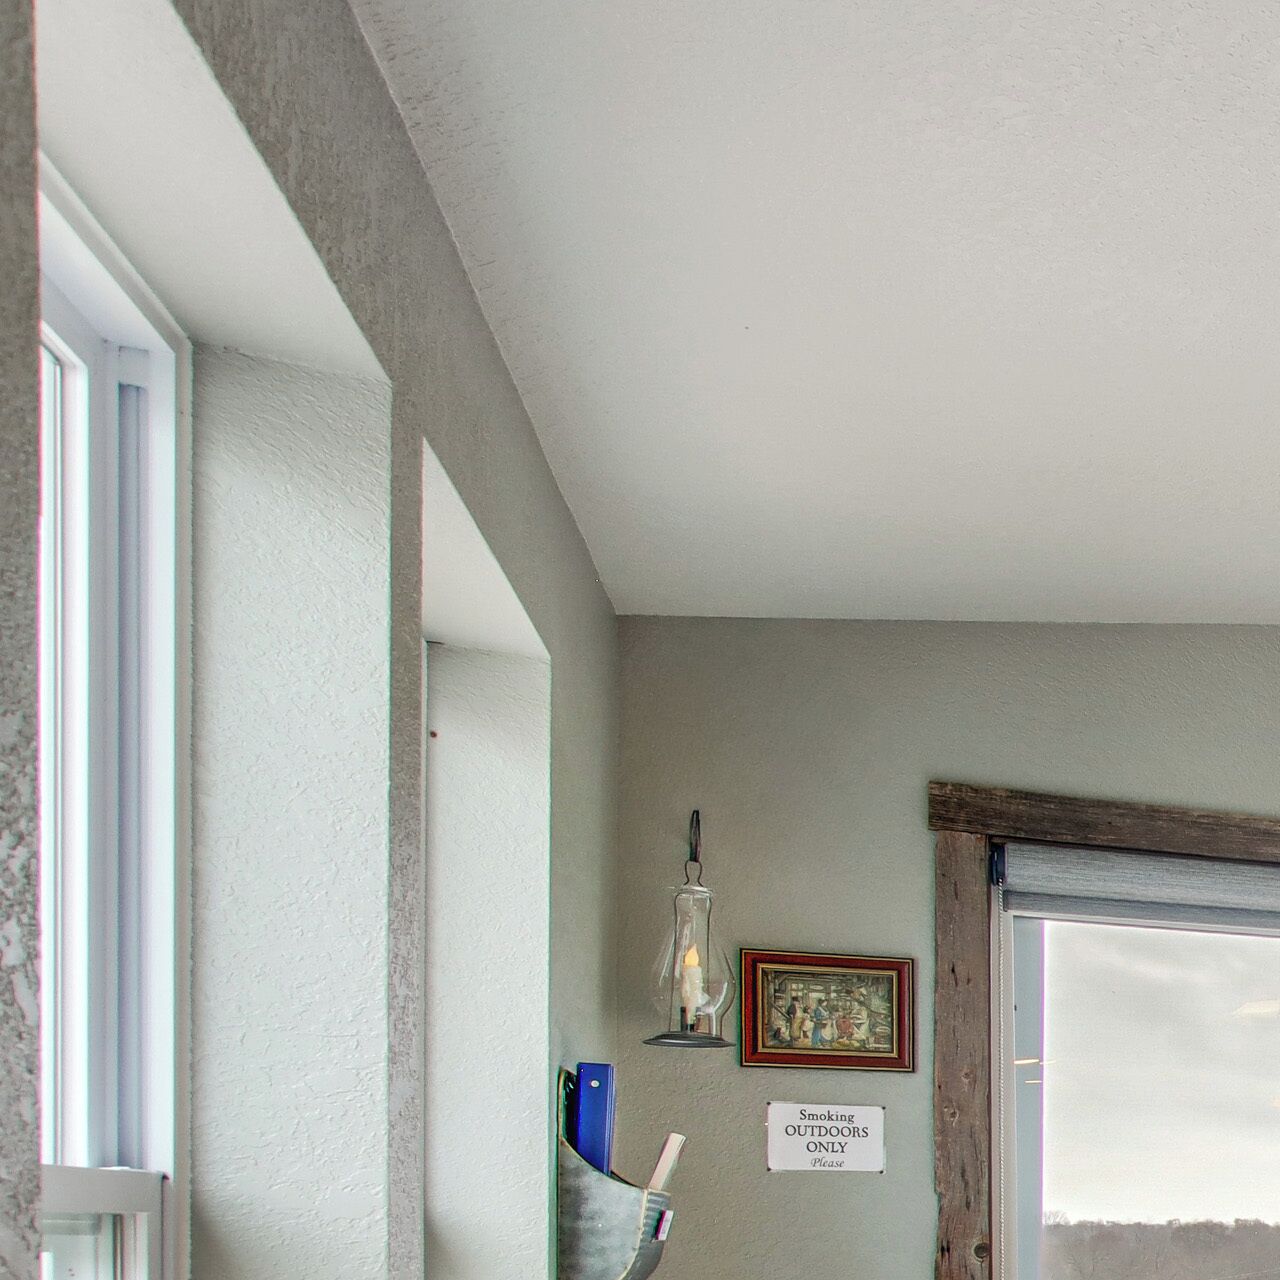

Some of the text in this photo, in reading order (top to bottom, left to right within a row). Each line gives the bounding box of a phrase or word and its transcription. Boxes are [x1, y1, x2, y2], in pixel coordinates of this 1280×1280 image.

[799, 1109, 855, 1124] Smoking
[785, 1124, 869, 1138] OUTDOORS
[806, 1141, 848, 1153] ONLY
[810, 1157, 845, 1168] Please
